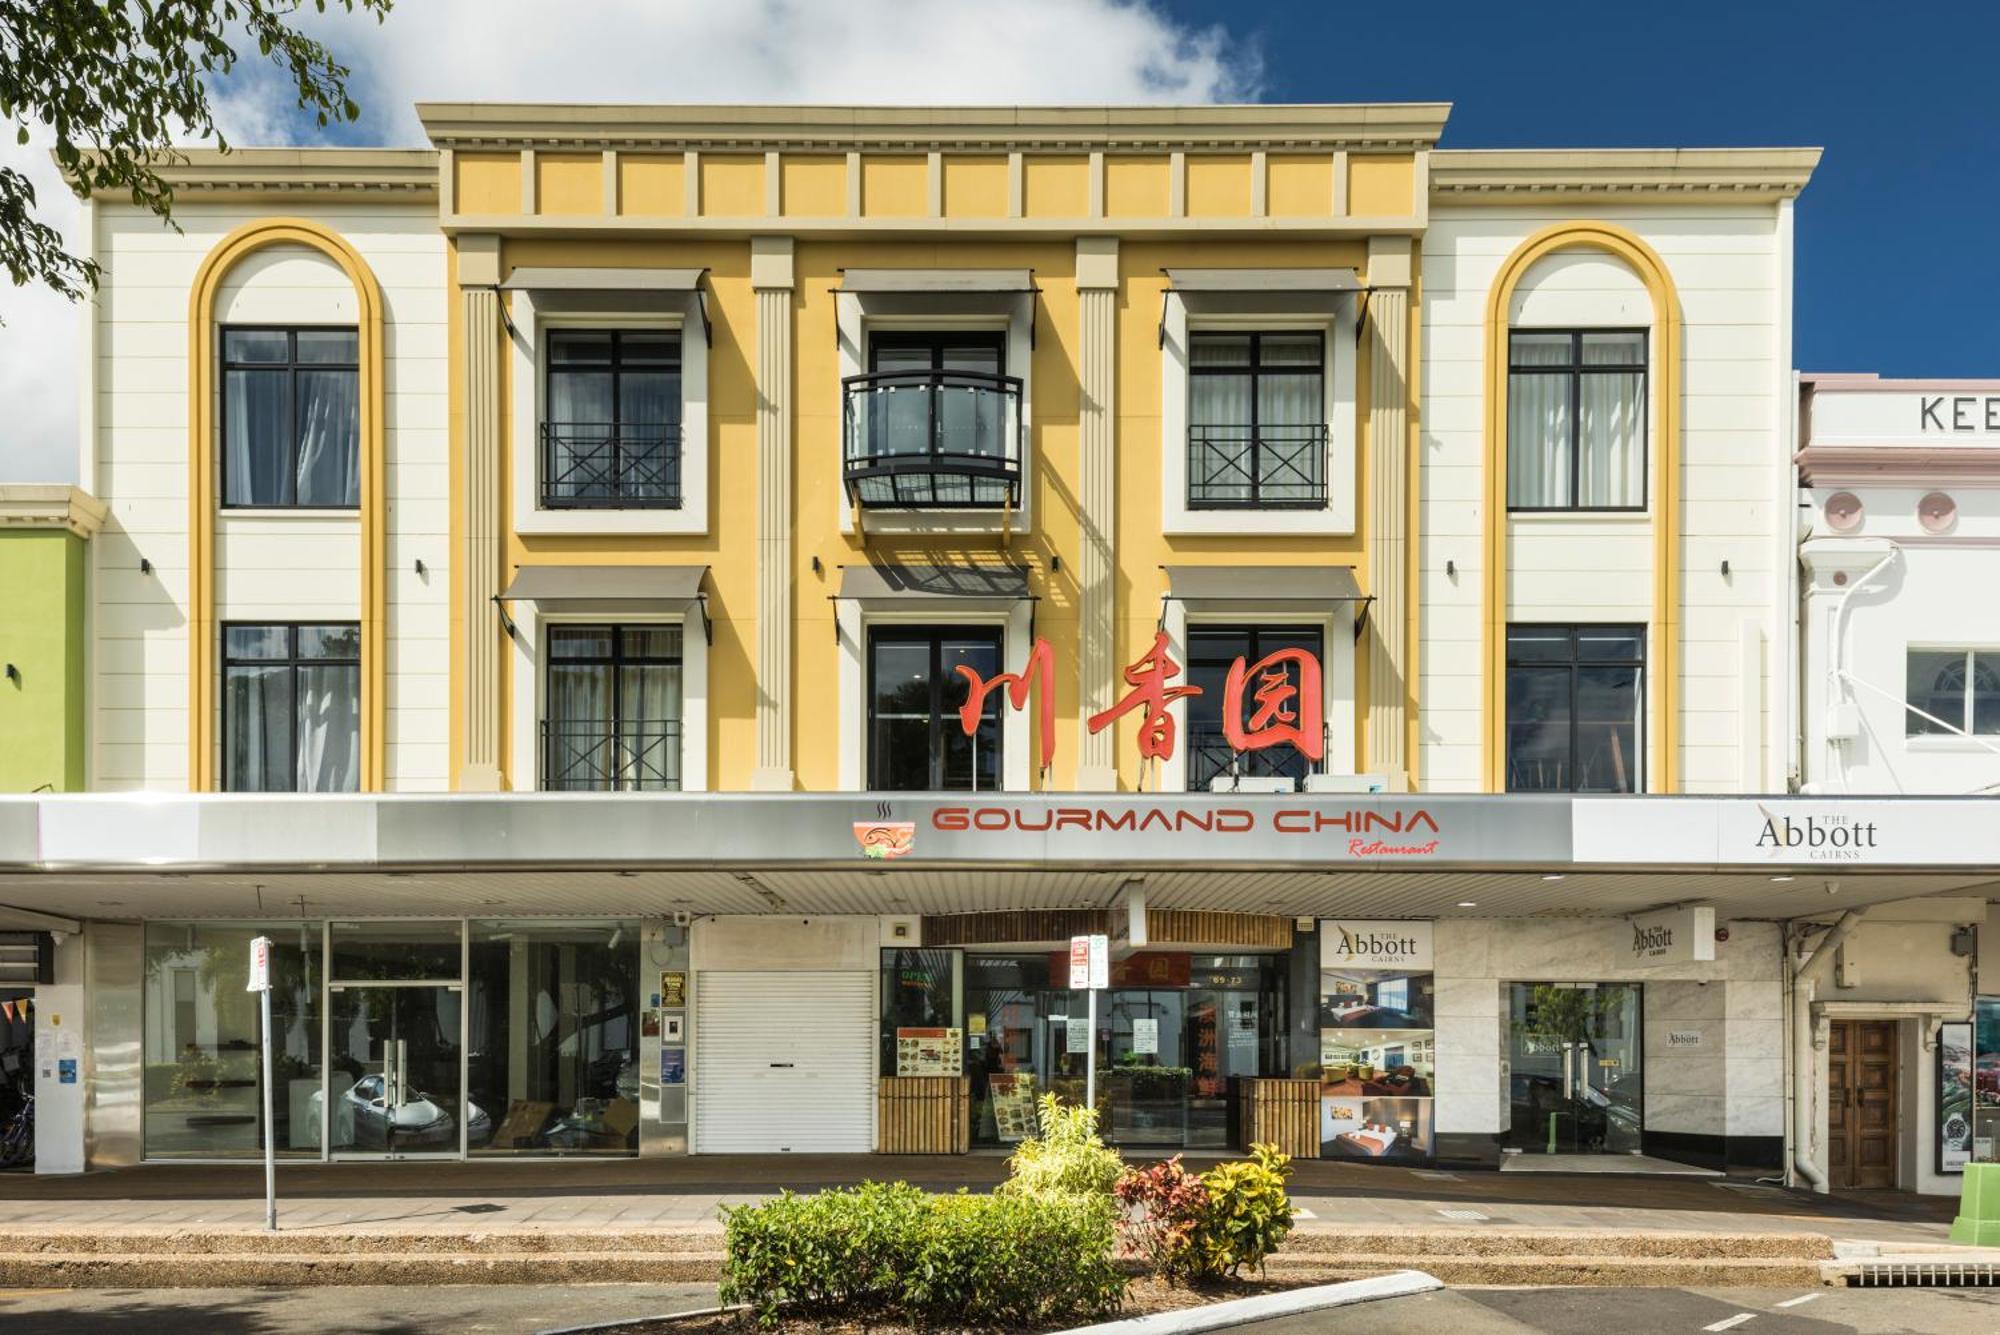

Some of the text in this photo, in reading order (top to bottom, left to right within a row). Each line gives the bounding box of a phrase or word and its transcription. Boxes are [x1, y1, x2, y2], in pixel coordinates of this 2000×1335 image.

[1921, 396, 2000, 430] KEE
[955, 630, 1323, 768] 川香园
[932, 807, 1440, 833] GOURMAND CHINA
[1755, 815, 1878, 847] Abbott
[1823, 815, 1848, 825] THE
[1348, 838, 1440, 857] Restaurant
[1810, 850, 1860, 859] CAIRNS
[1336, 933, 1416, 955] Abbott
[1381, 932, 1397, 940] THE
[1632, 927, 1673, 952] Abbott
[1668, 1033, 1698, 1045] Abbott
